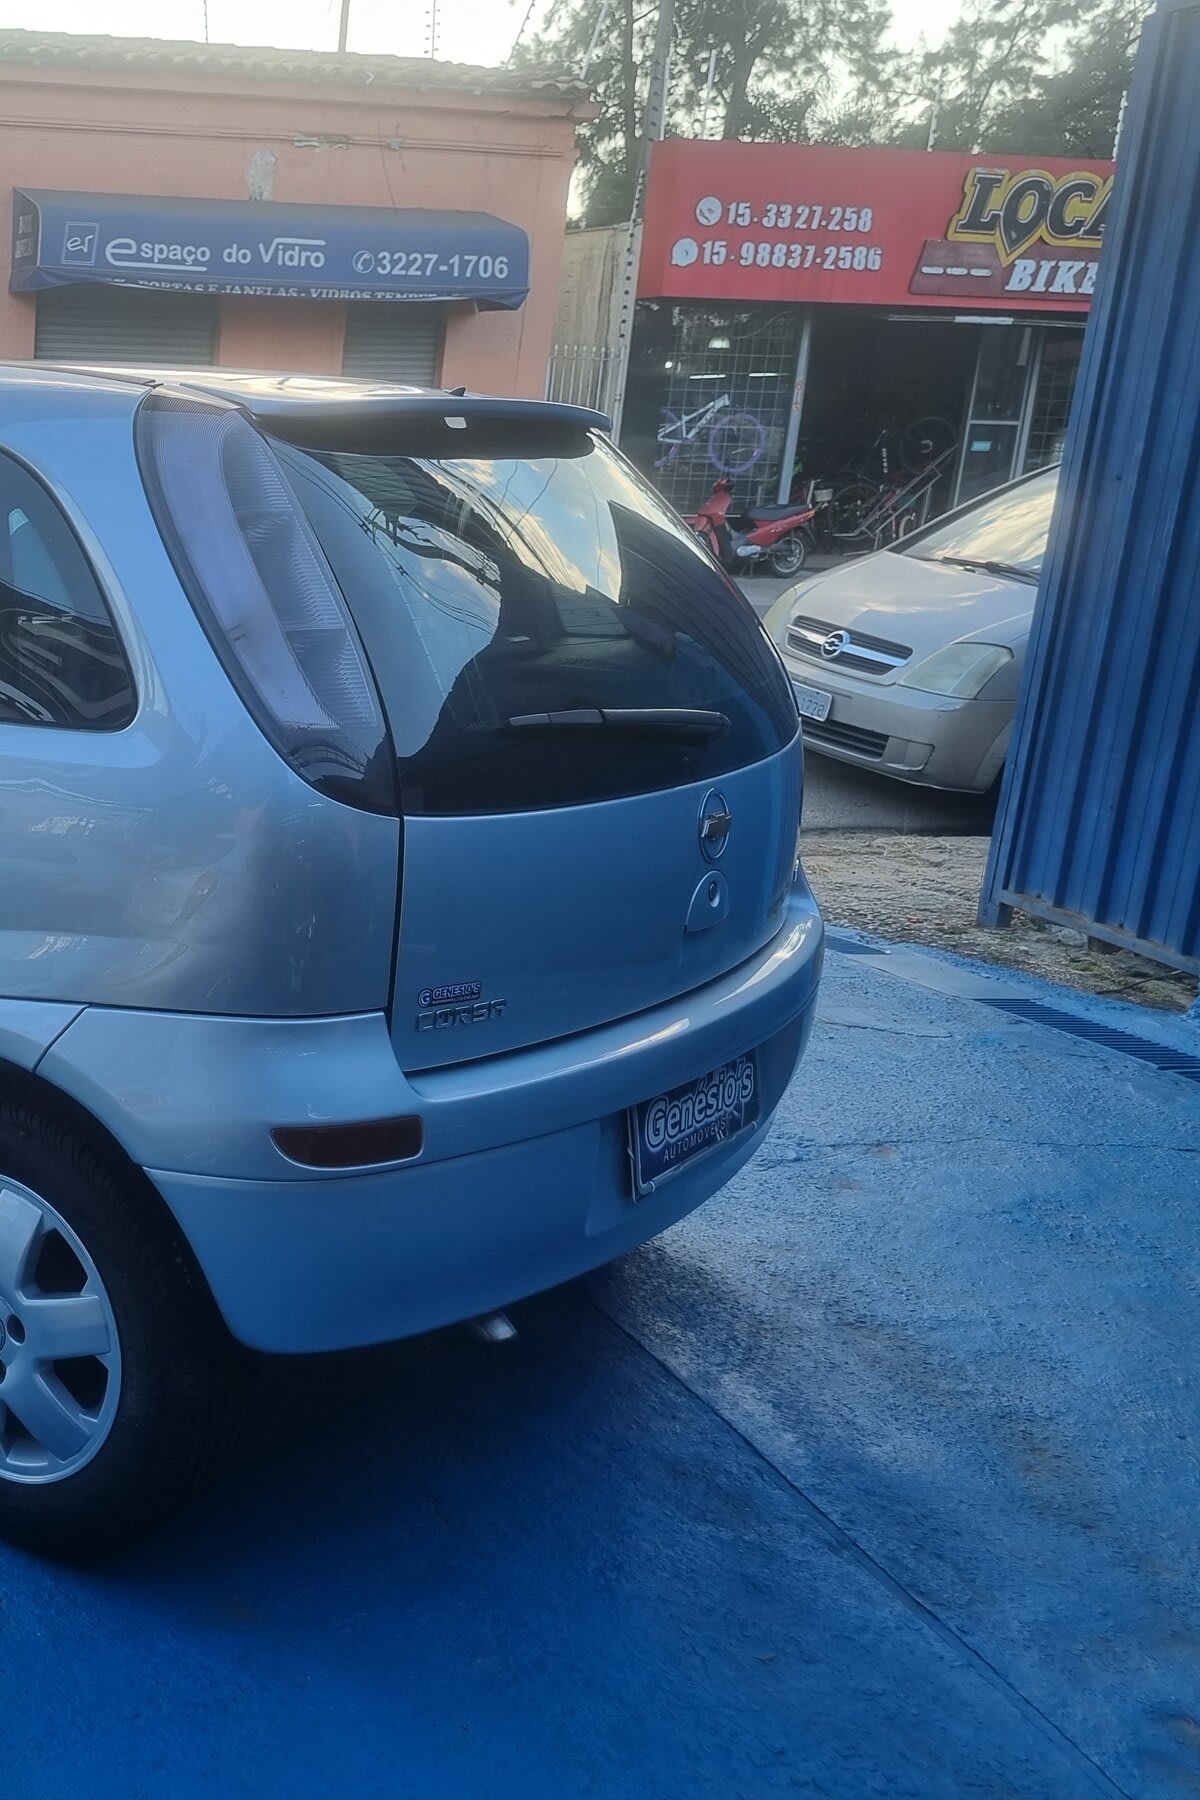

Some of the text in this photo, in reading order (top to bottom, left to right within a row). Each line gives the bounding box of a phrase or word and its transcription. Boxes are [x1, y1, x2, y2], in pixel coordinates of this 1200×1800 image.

[223, 244, 251, 264] do
[258, 237, 327, 267] Vidro
[376, 251, 509, 279] 3227-1706
[417, 998, 506, 1031] CORSA
